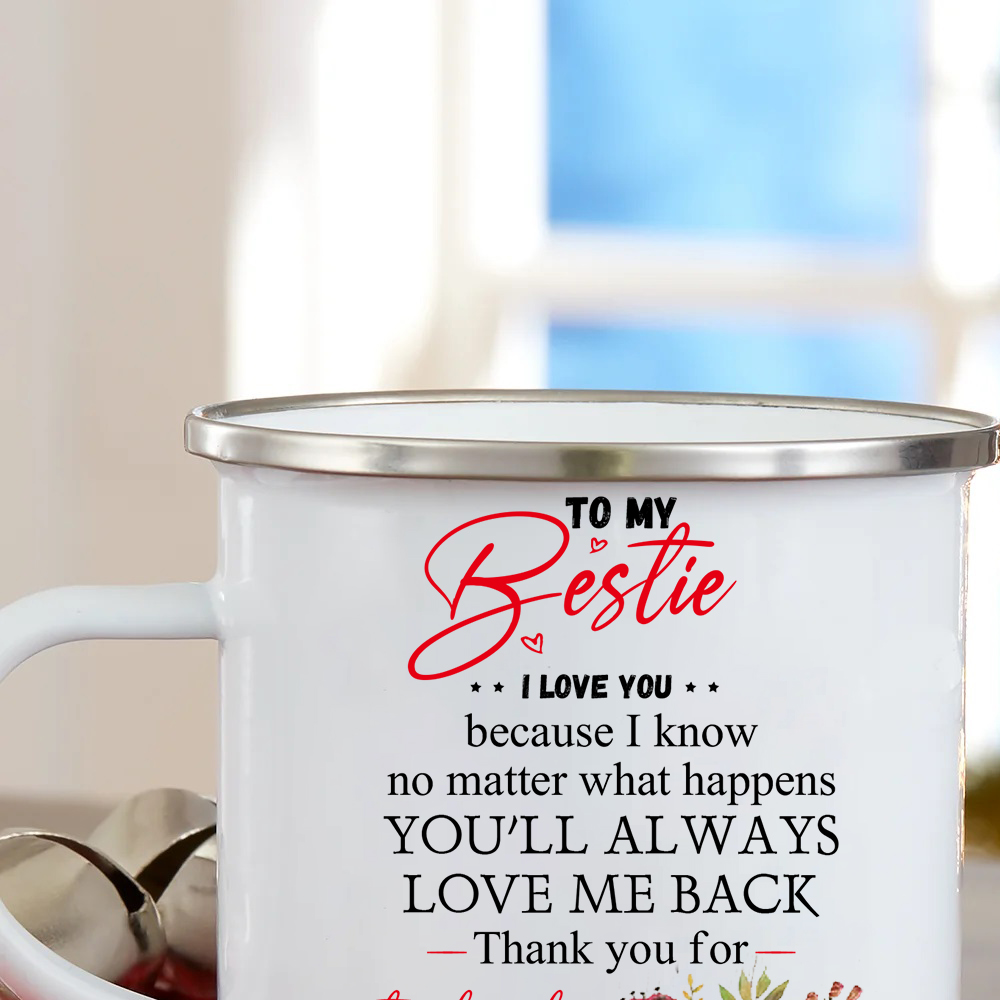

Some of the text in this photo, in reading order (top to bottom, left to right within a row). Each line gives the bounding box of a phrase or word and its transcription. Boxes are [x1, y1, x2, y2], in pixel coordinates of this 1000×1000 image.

[565, 495, 678, 529] TO MY
[407, 510, 737, 681] Bestie
[521, 673, 673, 699] I LOVE YOU
[464, 712, 759, 748] because I know
[387, 761, 836, 806] no matter what happens
[383, 814, 840, 856] YOU'LL ALWAYS
[402, 873, 820, 918] LOVE ME BACK
[473, 929, 749, 975] Thank you for
